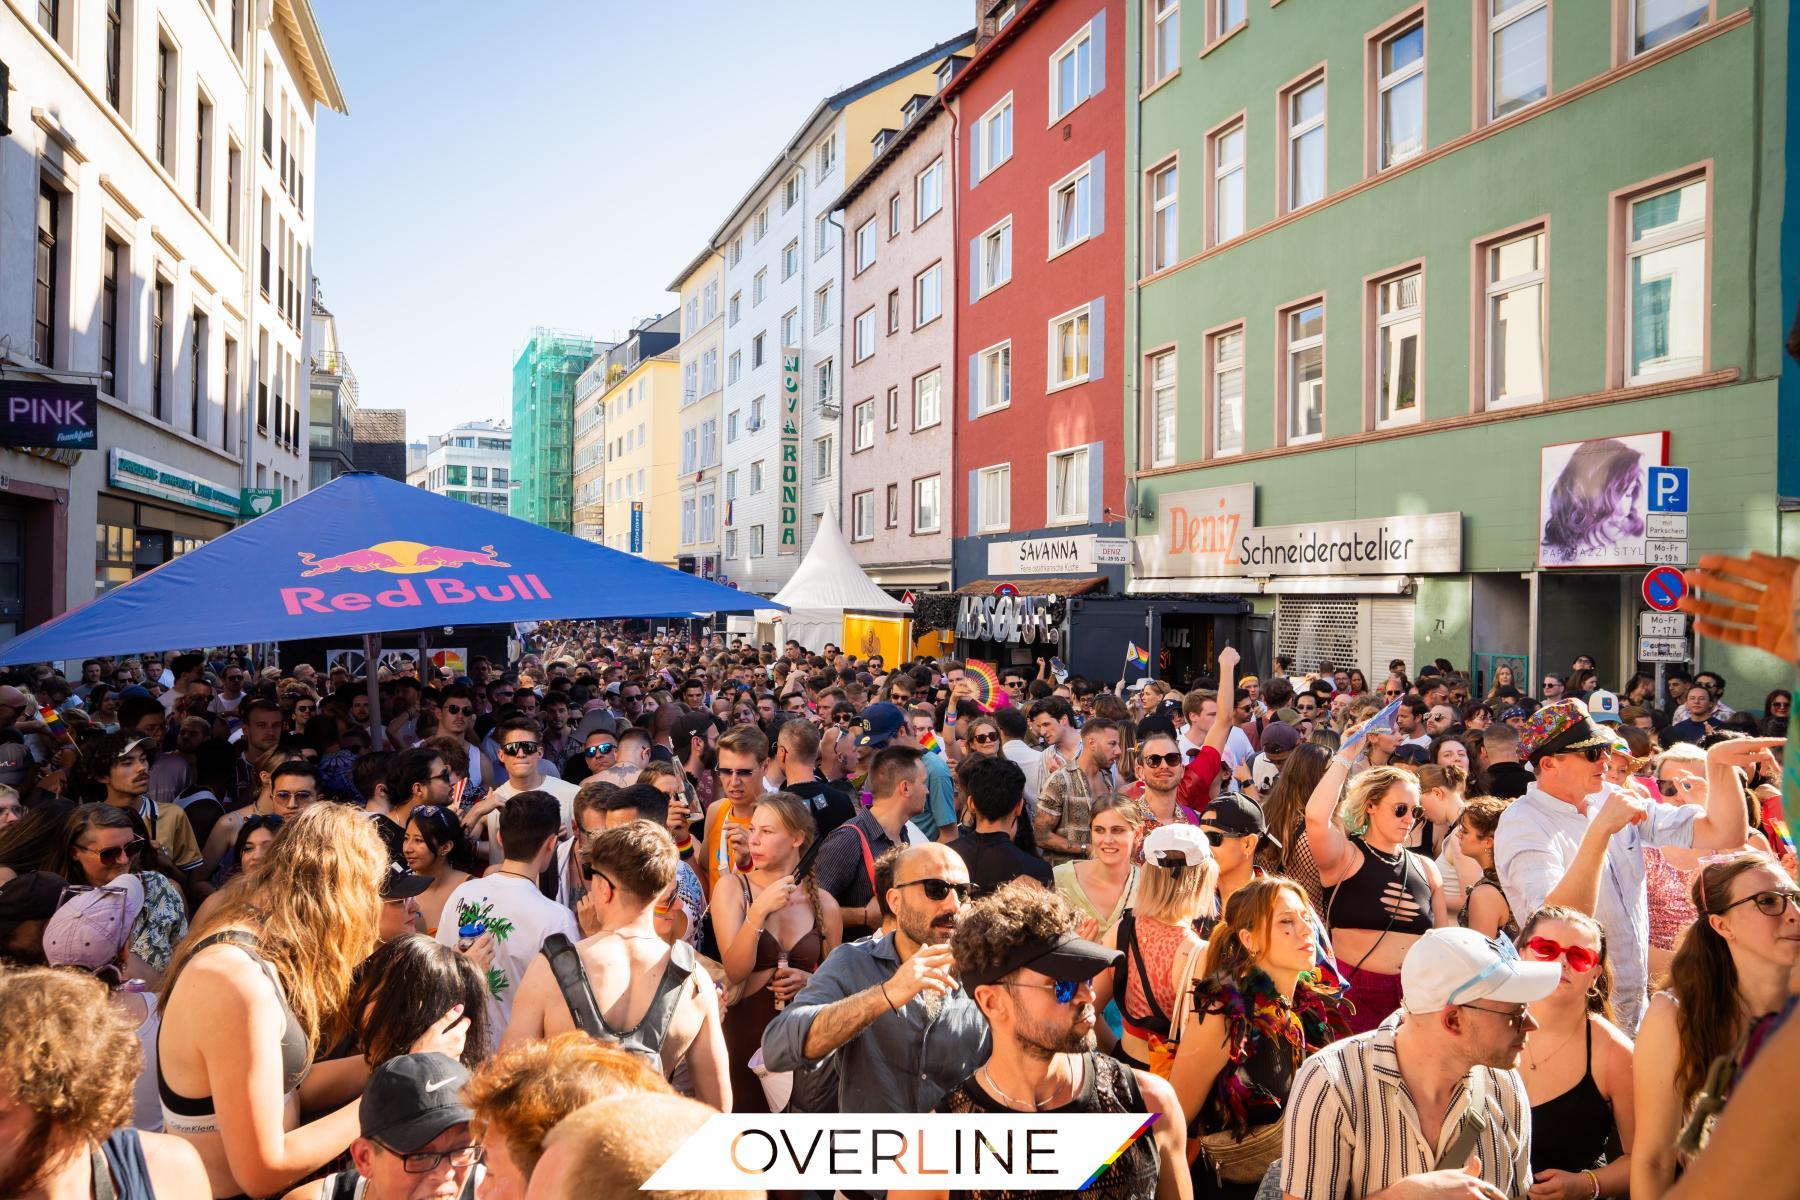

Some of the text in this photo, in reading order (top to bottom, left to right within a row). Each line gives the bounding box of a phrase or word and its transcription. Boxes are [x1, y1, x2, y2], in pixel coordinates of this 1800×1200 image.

[8, 396, 87, 426] PINK
[781, 354, 799, 545] NOVA RONDA
[1657, 472, 1680, 507] P
[1168, 498, 1414, 566] Deniz Schneideratelier
[1649, 527, 1685, 535] Parkschein
[1019, 540, 1078, 561] SAVANNA
[1542, 546, 1645, 559] PAPARAZZI STYL
[1654, 544, 1679, 552] Mo-Fr
[280, 573, 553, 616] Red Bull
[1651, 616, 1678, 624] Mo-Fr
[1642, 650, 1682, 658] Seiteeifen
[191, 1124, 215, 1133] Klein
